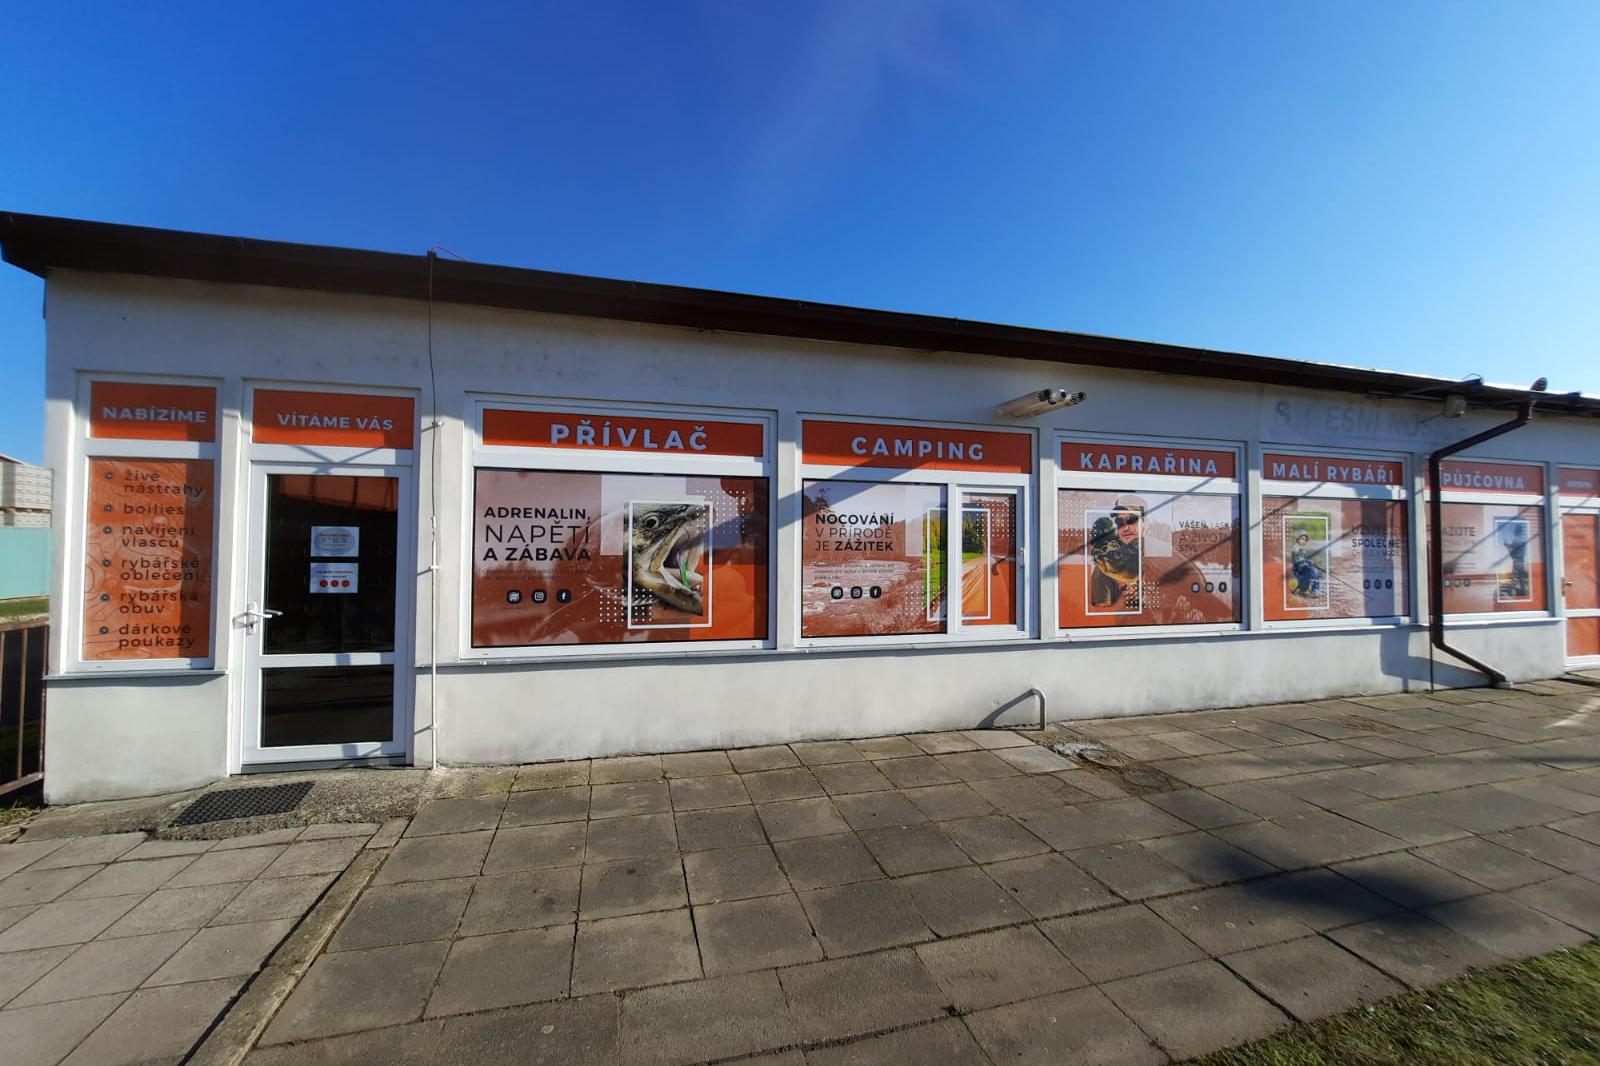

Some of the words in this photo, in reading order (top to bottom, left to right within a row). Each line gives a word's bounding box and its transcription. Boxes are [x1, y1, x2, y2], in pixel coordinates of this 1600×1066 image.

[102, 406, 208, 424] NABÍZÍME
[277, 411, 350, 429] VÍTÁME
[356, 415, 393, 431] VÁS
[550, 419, 708, 451] PŘÍVLAČ
[851, 436, 985, 461] CAMPING
[1080, 451, 1218, 475] KAPRAŘINA
[1272, 461, 1319, 480] MALÍ
[1327, 464, 1393, 483] RYBÁŘI
[1442, 468, 1525, 490] PŮJČOVNA
[123, 503, 184, 515] boilies
[484, 506, 591, 521] ADRENALIN,
[815, 512, 895, 525] NOCOVÁNÍ
[485, 520, 590, 544] NAPĚTÍ
[815, 528, 824, 538] V
[483, 547, 498, 561] A
[505, 544, 591, 561] ZÁBAVA
[815, 541, 831, 551] JE
[834, 538, 894, 551] ZÁŽITEK
[121, 556, 200, 571] rybářské
[119, 603, 165, 614] obuv
[118, 636, 195, 650] poukazy
